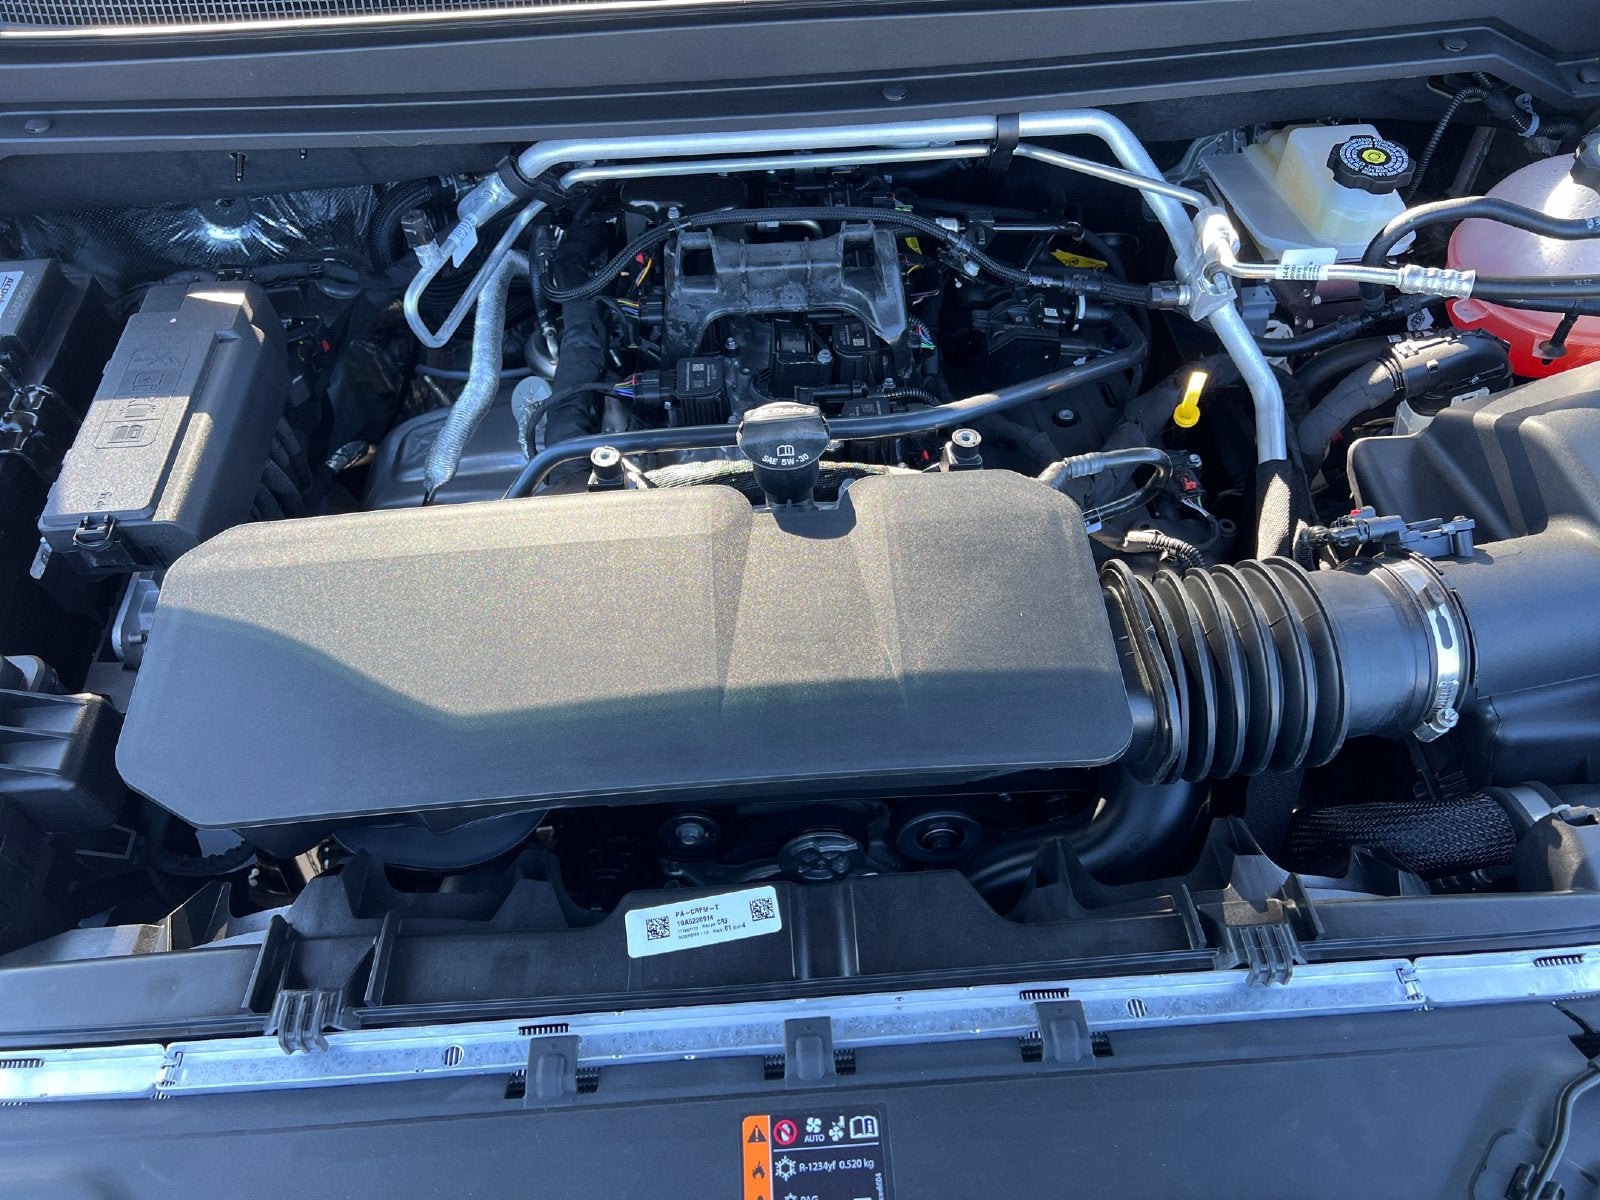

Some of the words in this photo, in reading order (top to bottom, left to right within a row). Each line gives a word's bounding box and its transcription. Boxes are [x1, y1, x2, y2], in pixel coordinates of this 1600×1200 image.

[762, 454, 779, 466] SAE
[781, 453, 809, 466] 5W-30
[804, 1134, 825, 1143] AUTO
[799, 1160, 836, 1173] R-1234yf
[839, 1159, 862, 1170] 0.520
[863, 1158, 874, 1170] kg
